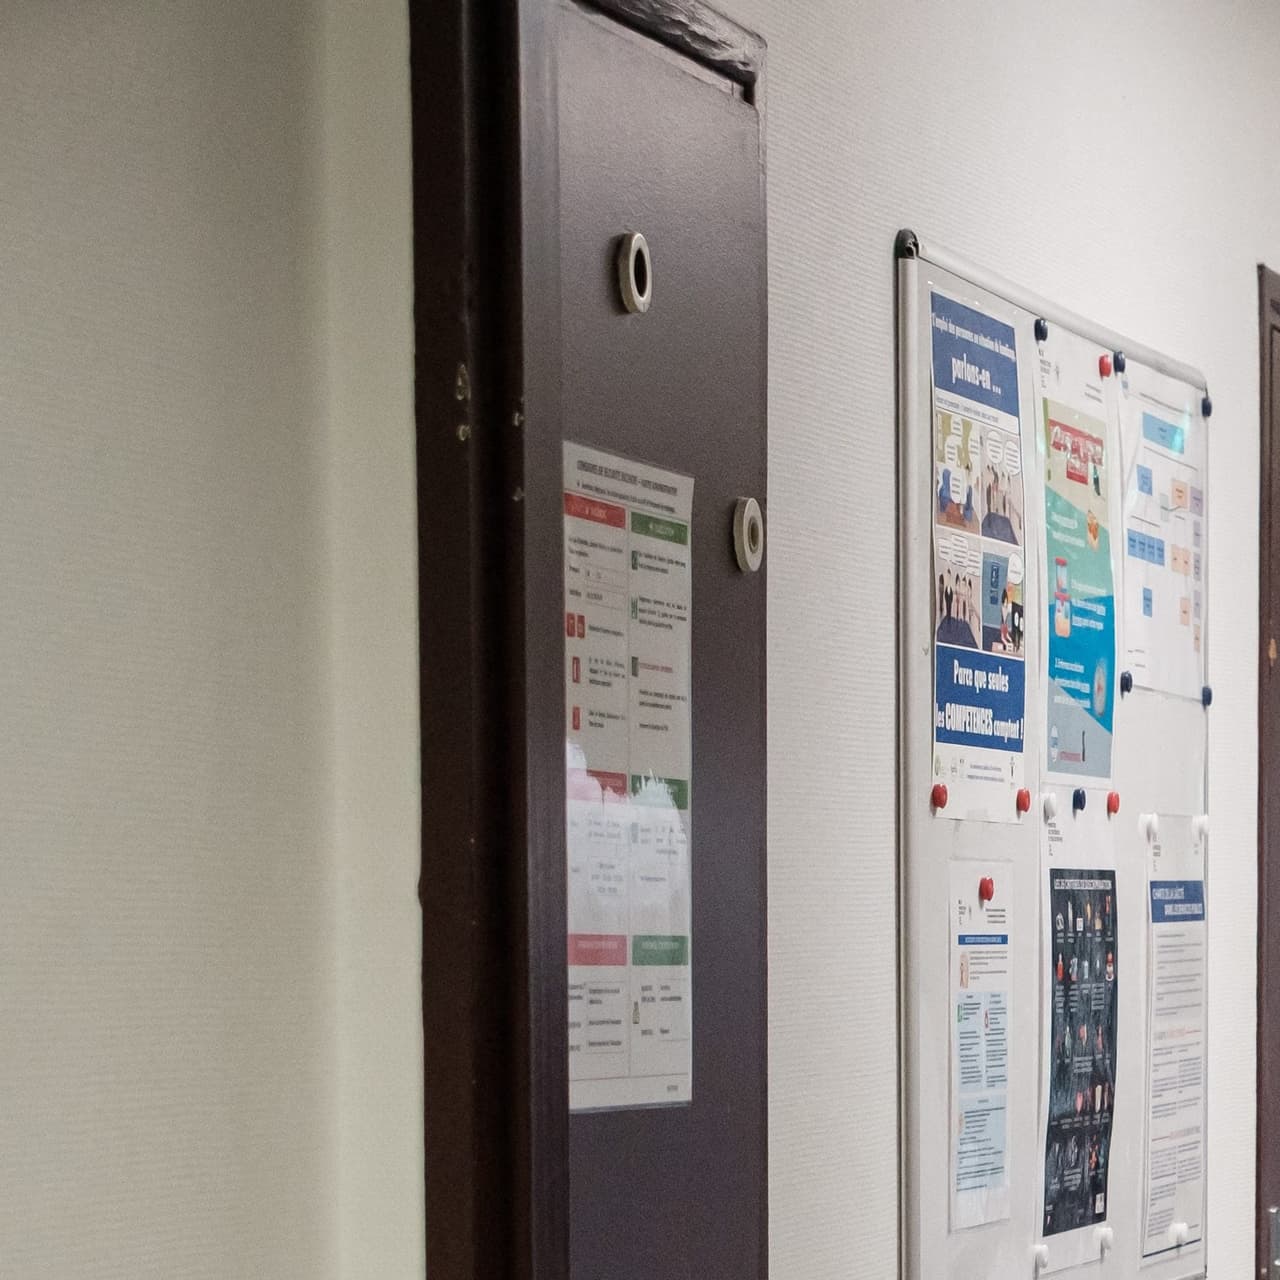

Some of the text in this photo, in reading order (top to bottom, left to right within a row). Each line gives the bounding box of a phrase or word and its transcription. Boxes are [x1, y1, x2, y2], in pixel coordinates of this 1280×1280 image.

[951, 353, 991, 390] parlons-en
[953, 659, 1009, 693] Parce que seules
[945, 702, 993, 736] COMPETENCES
[993, 718, 1020, 743] comptent
